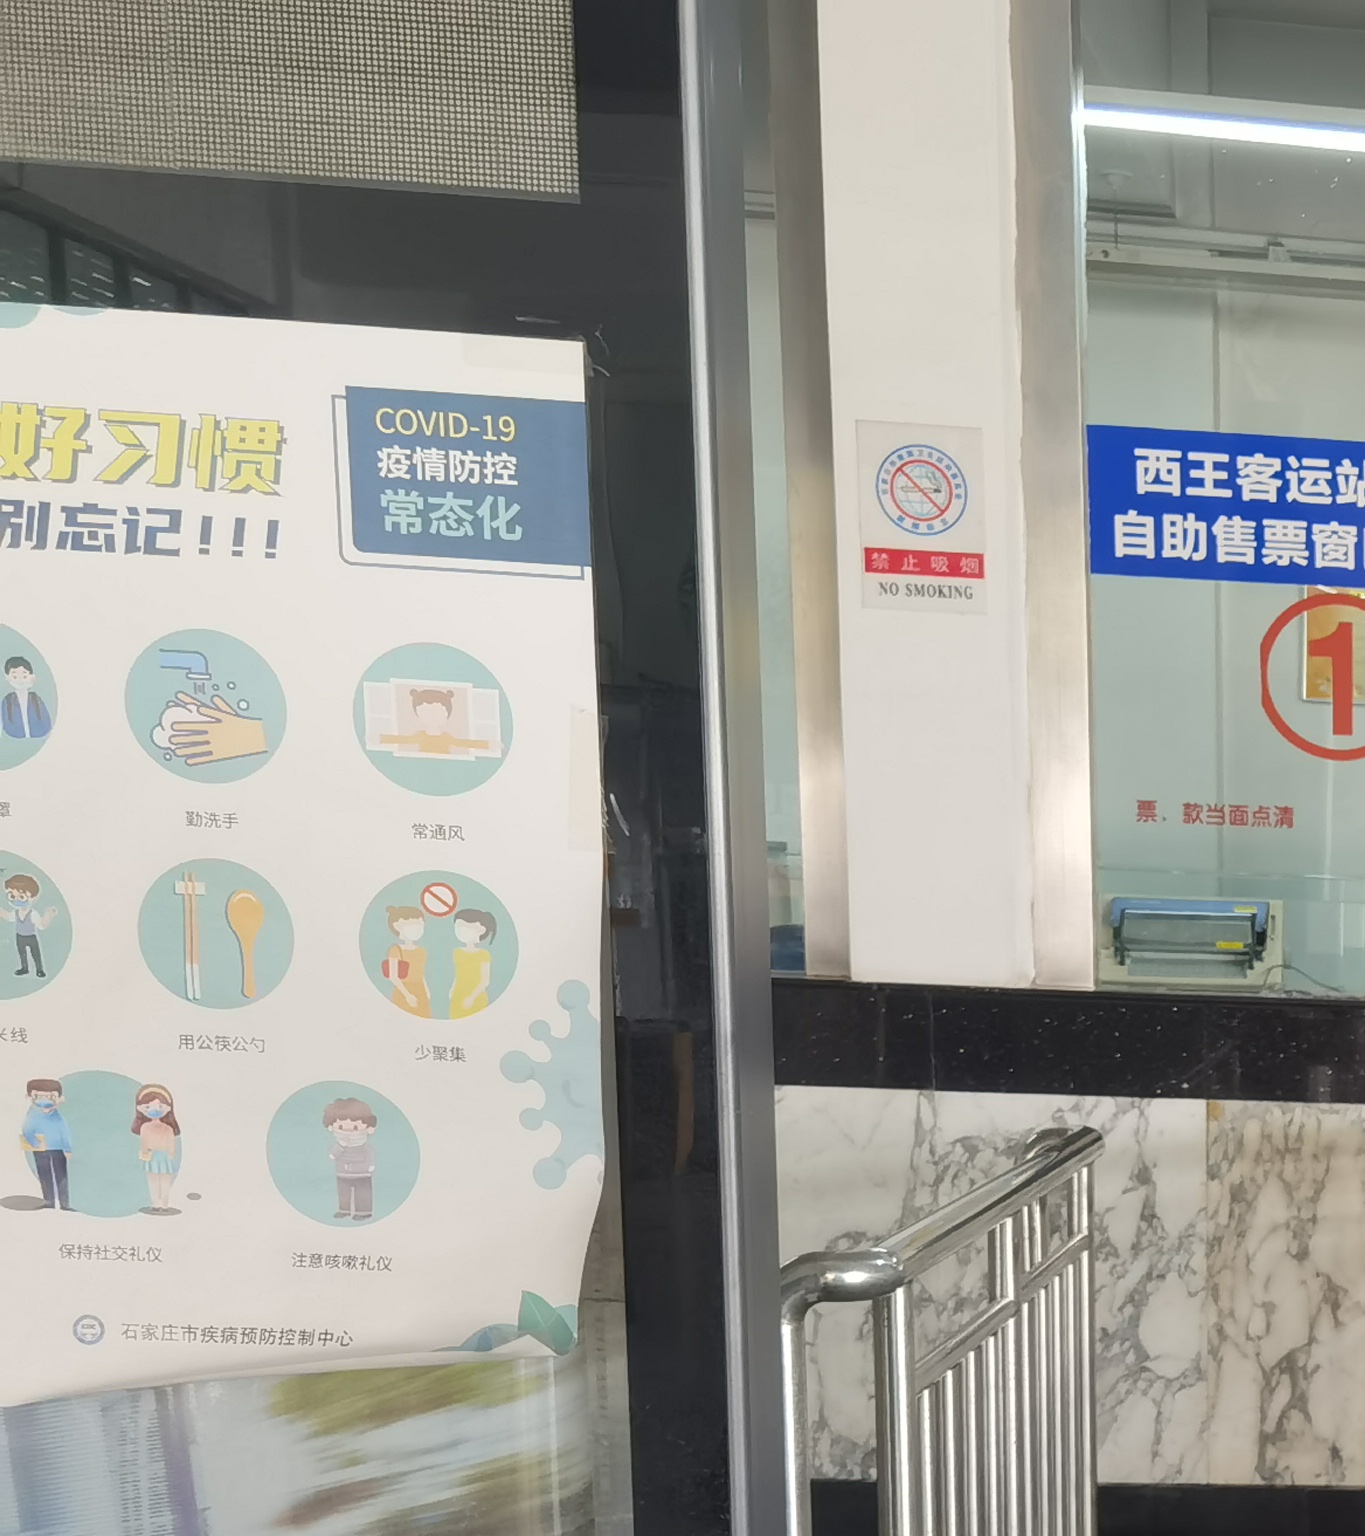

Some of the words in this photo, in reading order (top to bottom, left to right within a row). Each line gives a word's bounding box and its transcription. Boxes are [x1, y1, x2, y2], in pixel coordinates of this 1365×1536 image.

[374, 406, 517, 443] COVID-19
[376, 445, 519, 487] 疫情防控
[378, 488, 524, 542] 常态化
[871, 551, 980, 575] 禁止吸烟
[878, 581, 900, 597] NO
[905, 582, 974, 600] SMOKING
[184, 809, 240, 831] 勤洗手
[410, 821, 466, 844] 常通风
[177, 1033, 266, 1056] 用公筷公勺
[413, 1043, 468, 1065] 少聚集
[58, 1243, 164, 1265] 保持社交礼仪
[290, 1252, 394, 1274] 注意咳嗽礼仪
[120, 1321, 355, 1349] 石家庄市疾病预防控制中心
